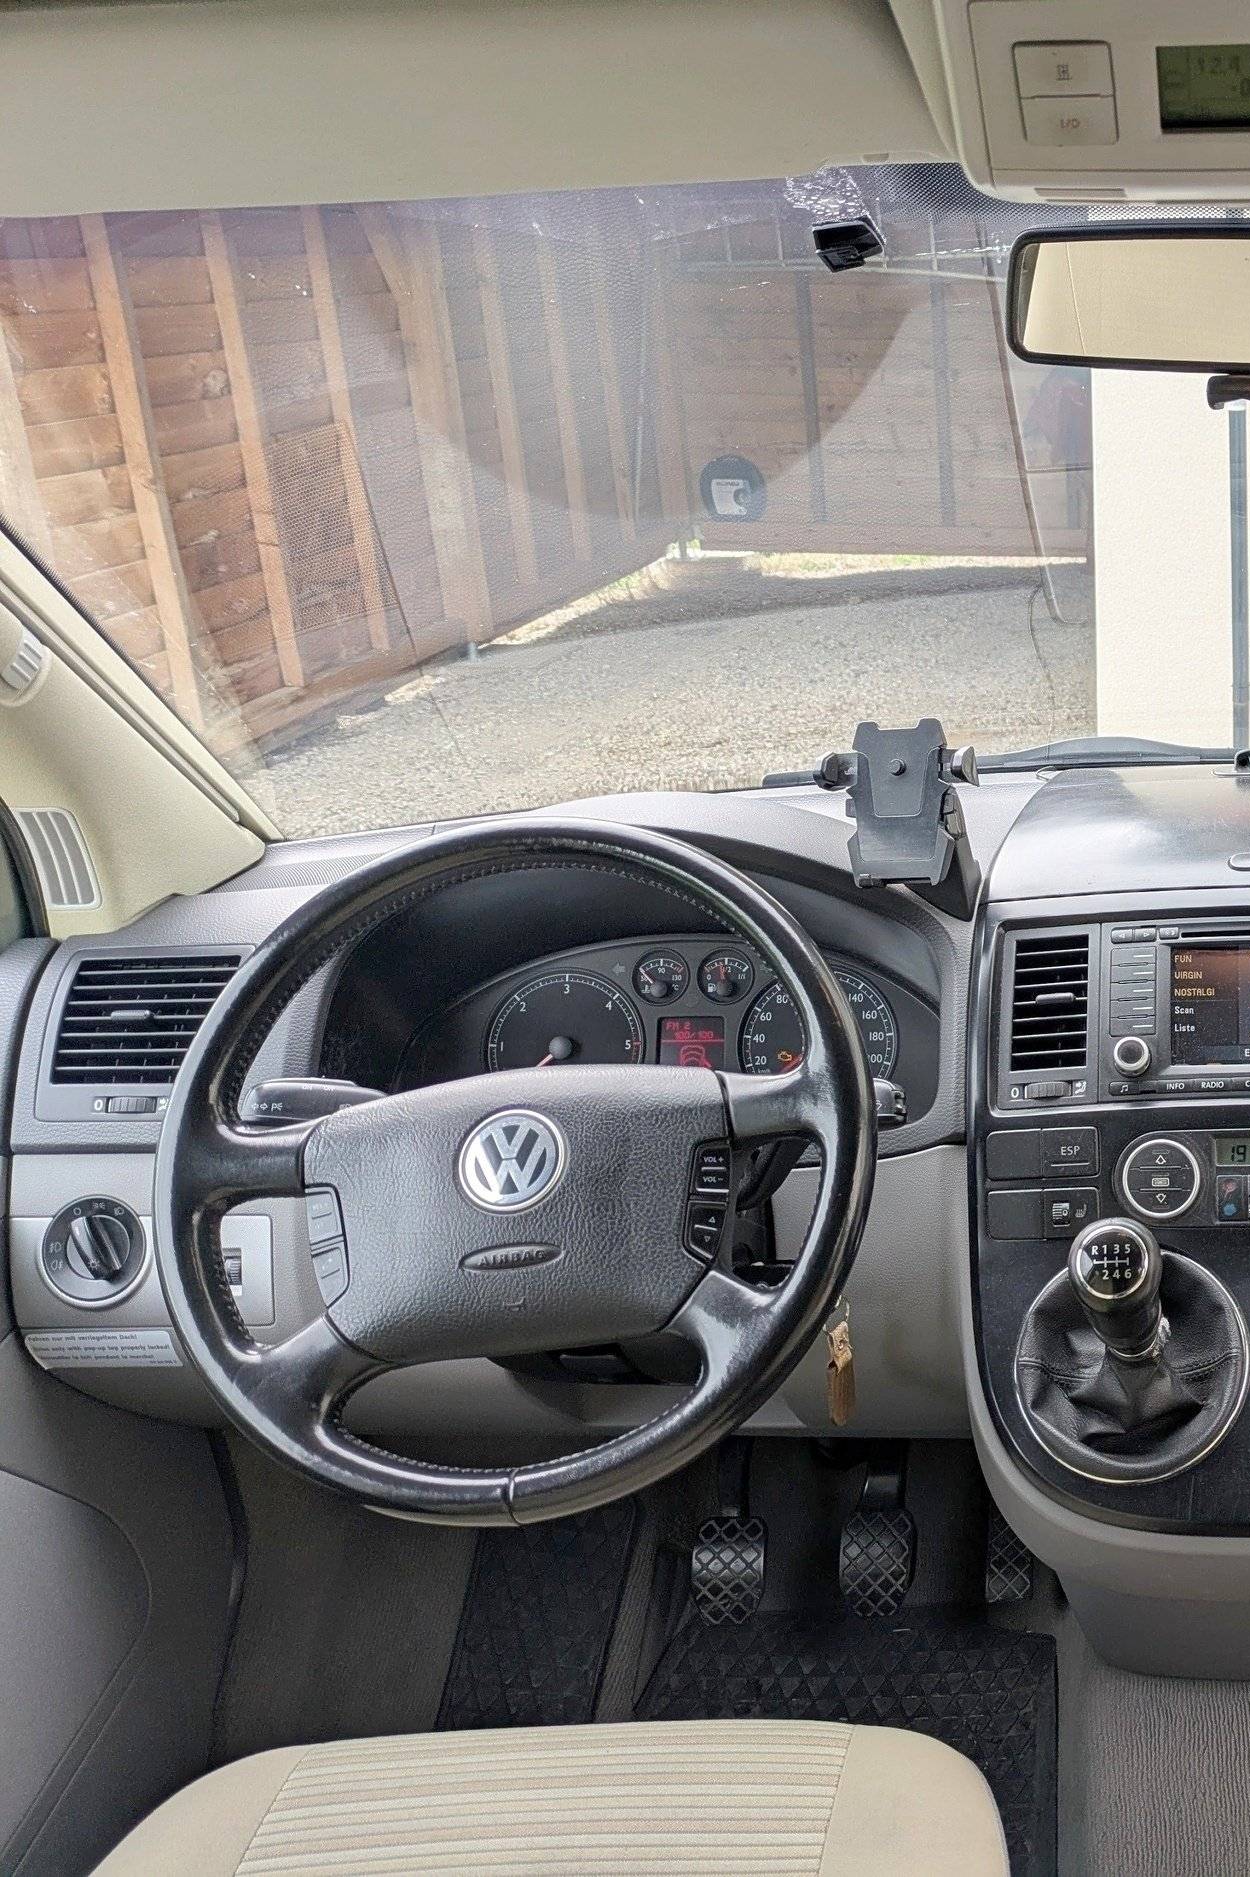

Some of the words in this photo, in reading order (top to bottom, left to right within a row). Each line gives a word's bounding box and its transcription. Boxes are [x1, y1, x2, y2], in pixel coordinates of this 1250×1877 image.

[1174, 955, 1192, 963] FUN
[563, 984, 570, 995] 3
[1174, 988, 1215, 997] NOSTALGI
[776, 994, 788, 1004] 80
[519, 1001, 527, 1013] 2
[605, 1001, 613, 1011] 4
[1174, 1006, 1194, 1014] Scan
[760, 1012, 772, 1021] 60
[862, 1010, 877, 1020] 160
[1174, 1024, 1196, 1032] Liste
[752, 1033, 766, 1043] 40
[869, 1031, 885, 1041] 180
[624, 1040, 631, 1050] 5
[755, 1055, 767, 1066] 20
[1166, 1082, 1185, 1091] INFO
[1201, 1081, 1225, 1089] RADIO
[1010, 1087, 1019, 1099] 0
[94, 1100, 103, 1111] 0
[1060, 1146, 1080, 1156] ESP
[1091, 1245, 1099, 1255] R
[1113, 1244, 1120, 1254] 3
[1124, 1244, 1131, 1254] 5
[1102, 1269, 1109, 1280] 2
[1113, 1269, 1120, 1279] 4
[1124, 1269, 1132, 1279] 6
